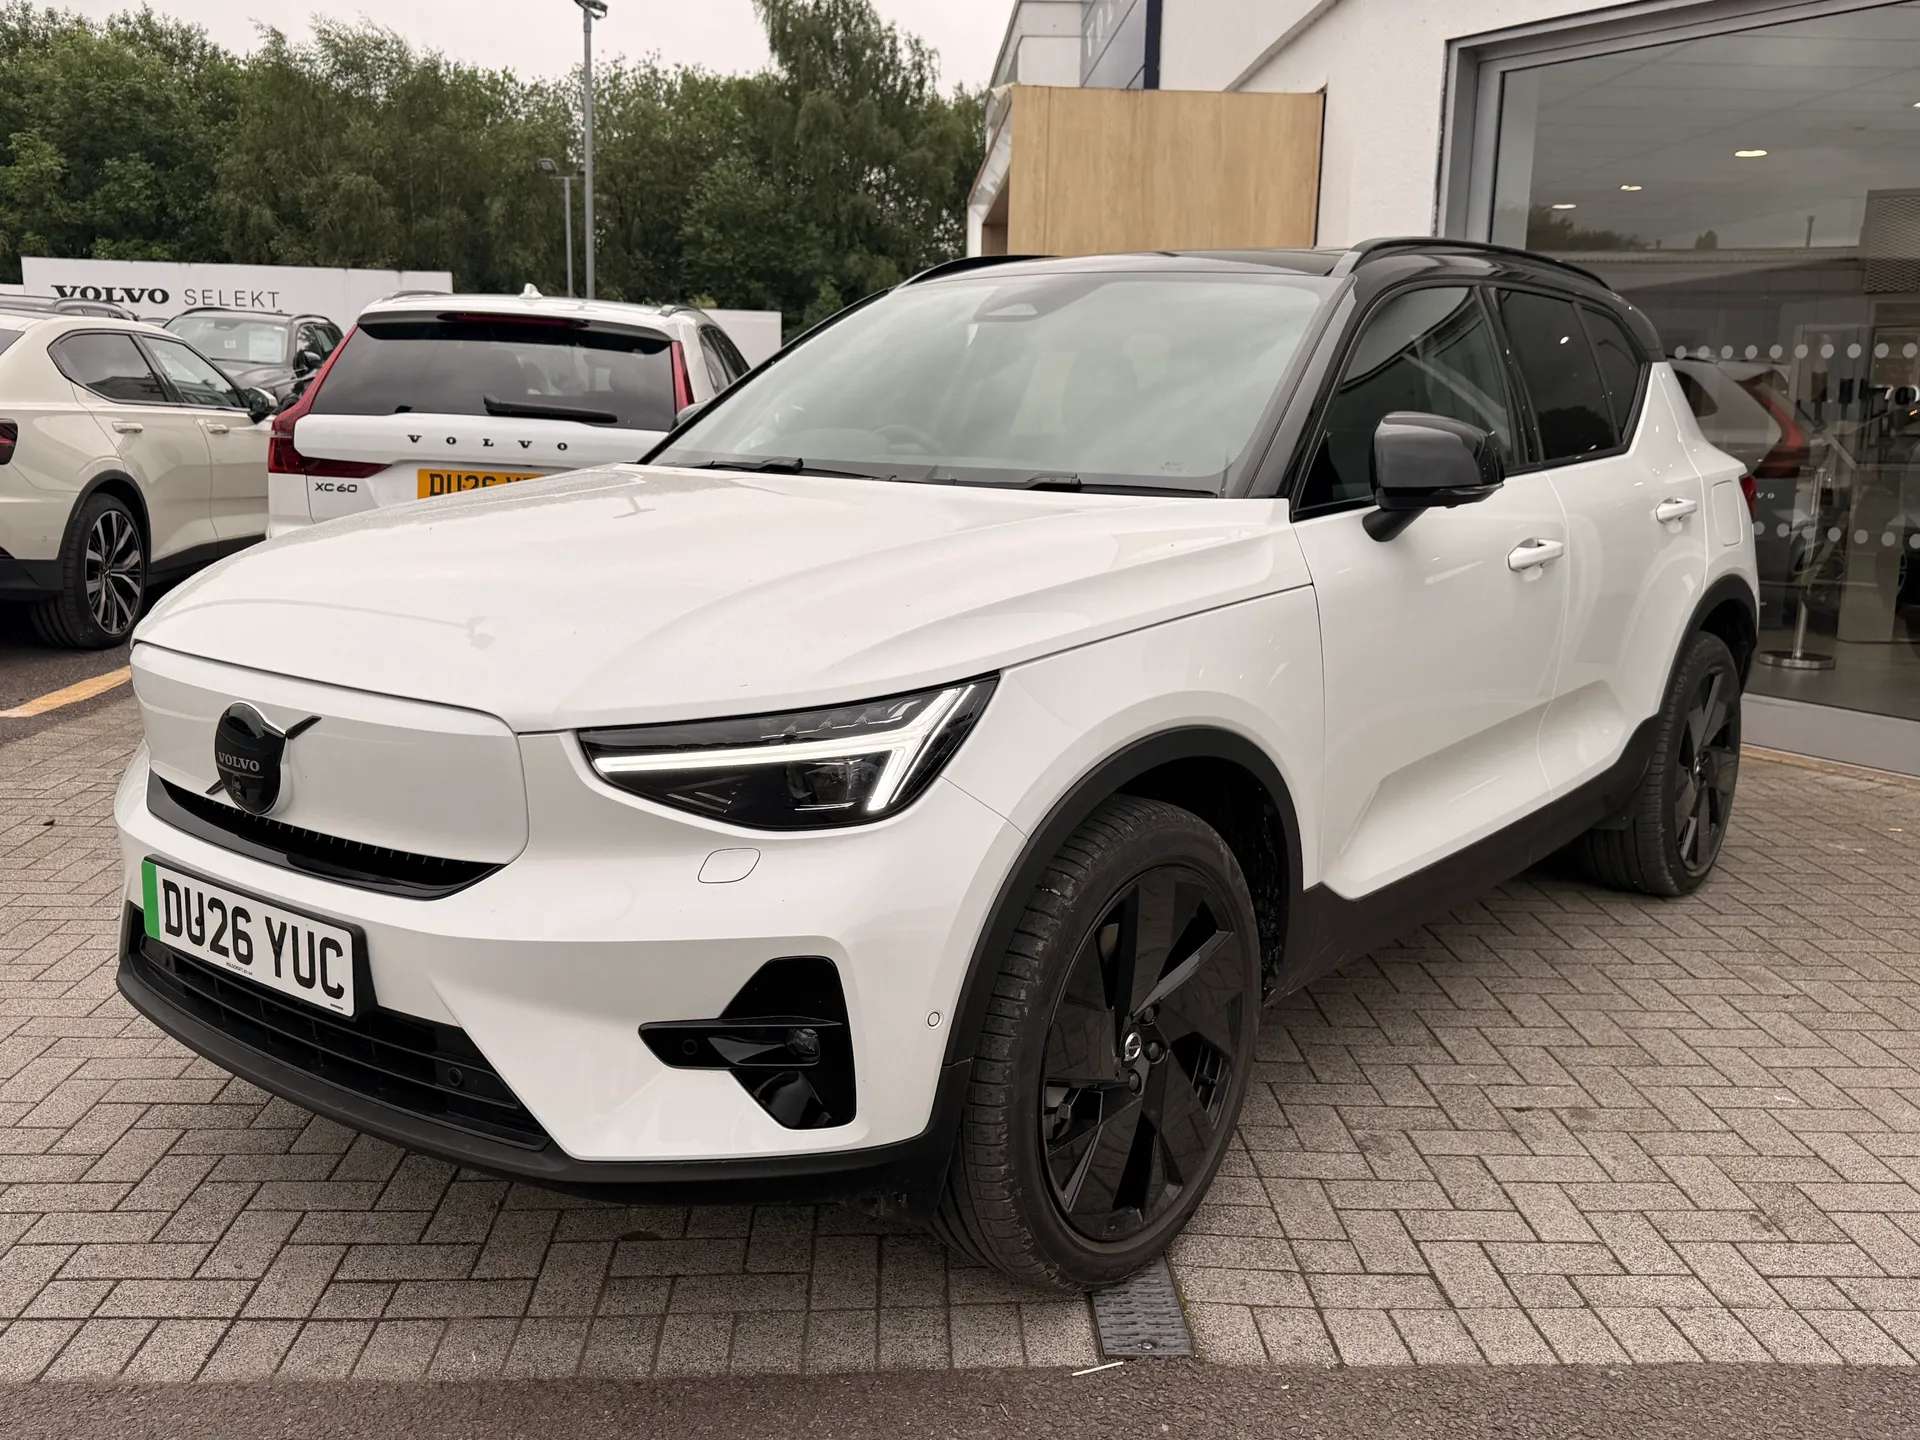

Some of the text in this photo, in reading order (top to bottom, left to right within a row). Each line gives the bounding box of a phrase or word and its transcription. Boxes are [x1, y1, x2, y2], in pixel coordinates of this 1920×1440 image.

[51, 285, 280, 308] VOLVO SELEKT
[408, 434, 568, 451] VOLVO
[218, 751, 260, 772] VOLVO
[162, 878, 345, 1000] DU26 YUC
